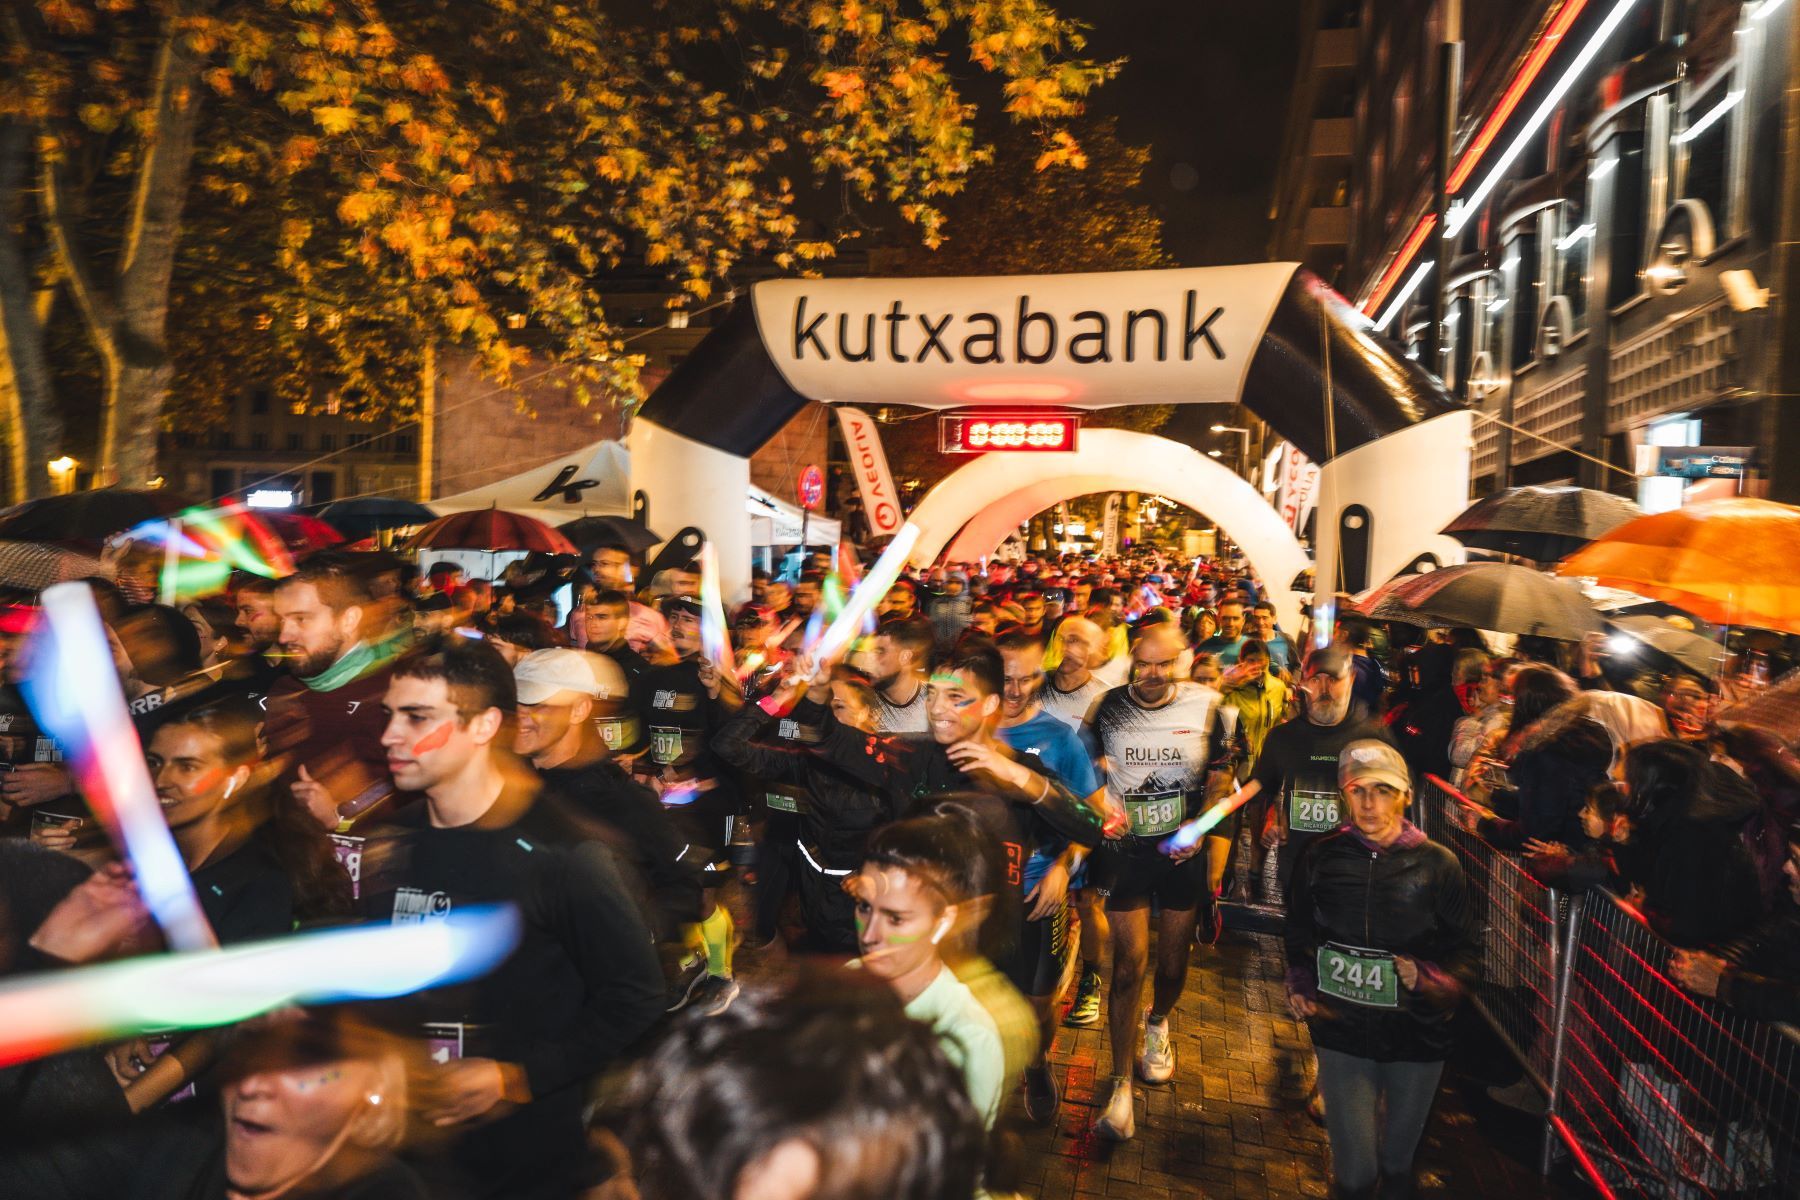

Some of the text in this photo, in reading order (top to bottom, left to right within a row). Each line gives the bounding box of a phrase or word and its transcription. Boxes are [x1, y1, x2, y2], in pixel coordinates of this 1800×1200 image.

[791, 289, 1227, 365] kutxabank
[1125, 747, 1182, 761] RULISA
[1134, 802, 1174, 826] 158
[1299, 801, 1339, 823] 266
[1329, 956, 1384, 991] 244
